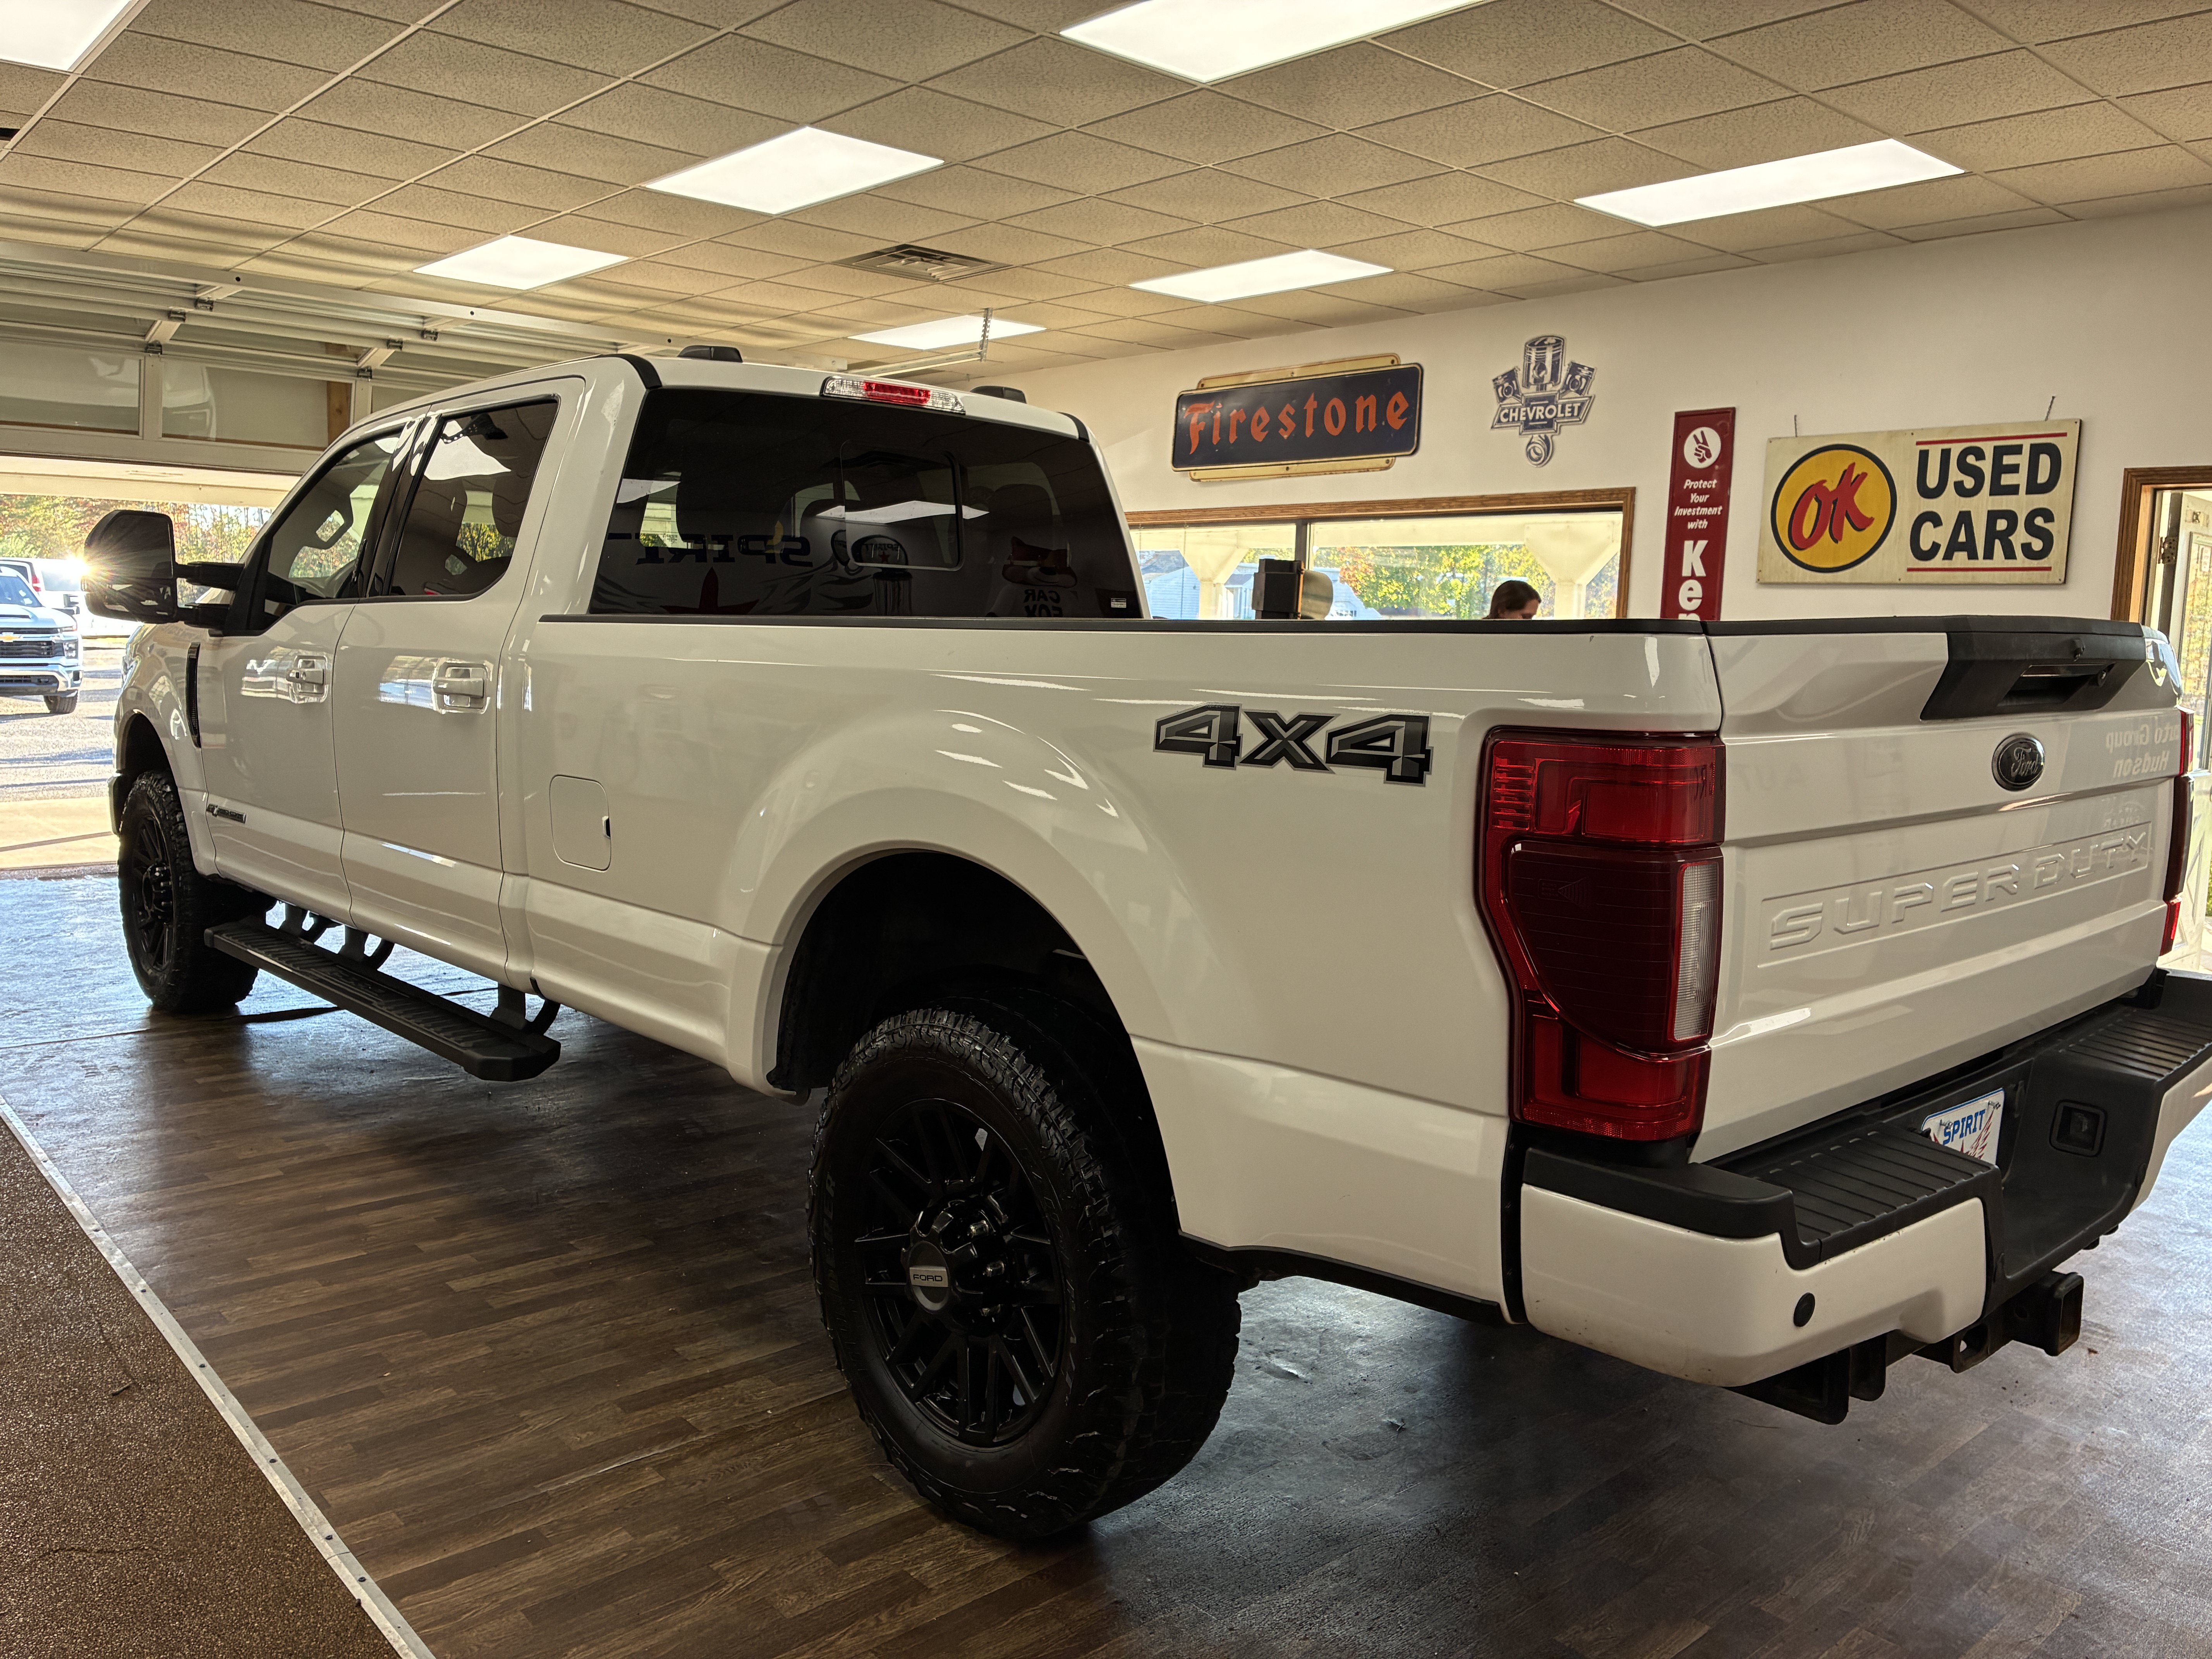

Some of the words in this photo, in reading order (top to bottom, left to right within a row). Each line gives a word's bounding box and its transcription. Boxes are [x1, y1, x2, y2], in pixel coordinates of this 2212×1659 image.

[1183, 391, 1409, 455] Firestone
[1499, 403, 1581, 422] CHEVROLET
[1683, 479, 1717, 489] Protect
[1917, 442, 2062, 499] USED
[1674, 505, 1723, 516] Investment
[1690, 493, 1709, 503] Your
[1788, 462, 1875, 551] OK
[1687, 519, 1708, 529] with
[1909, 508, 2055, 562] CARS
[1153, 701, 1434, 787] 4X4
[1770, 864, 2020, 951] SUPER
[2034, 831, 2147, 890] DUTY
[1942, 1109, 1986, 1146] SPIRIT
[913, 1274, 943, 1282] FORD
